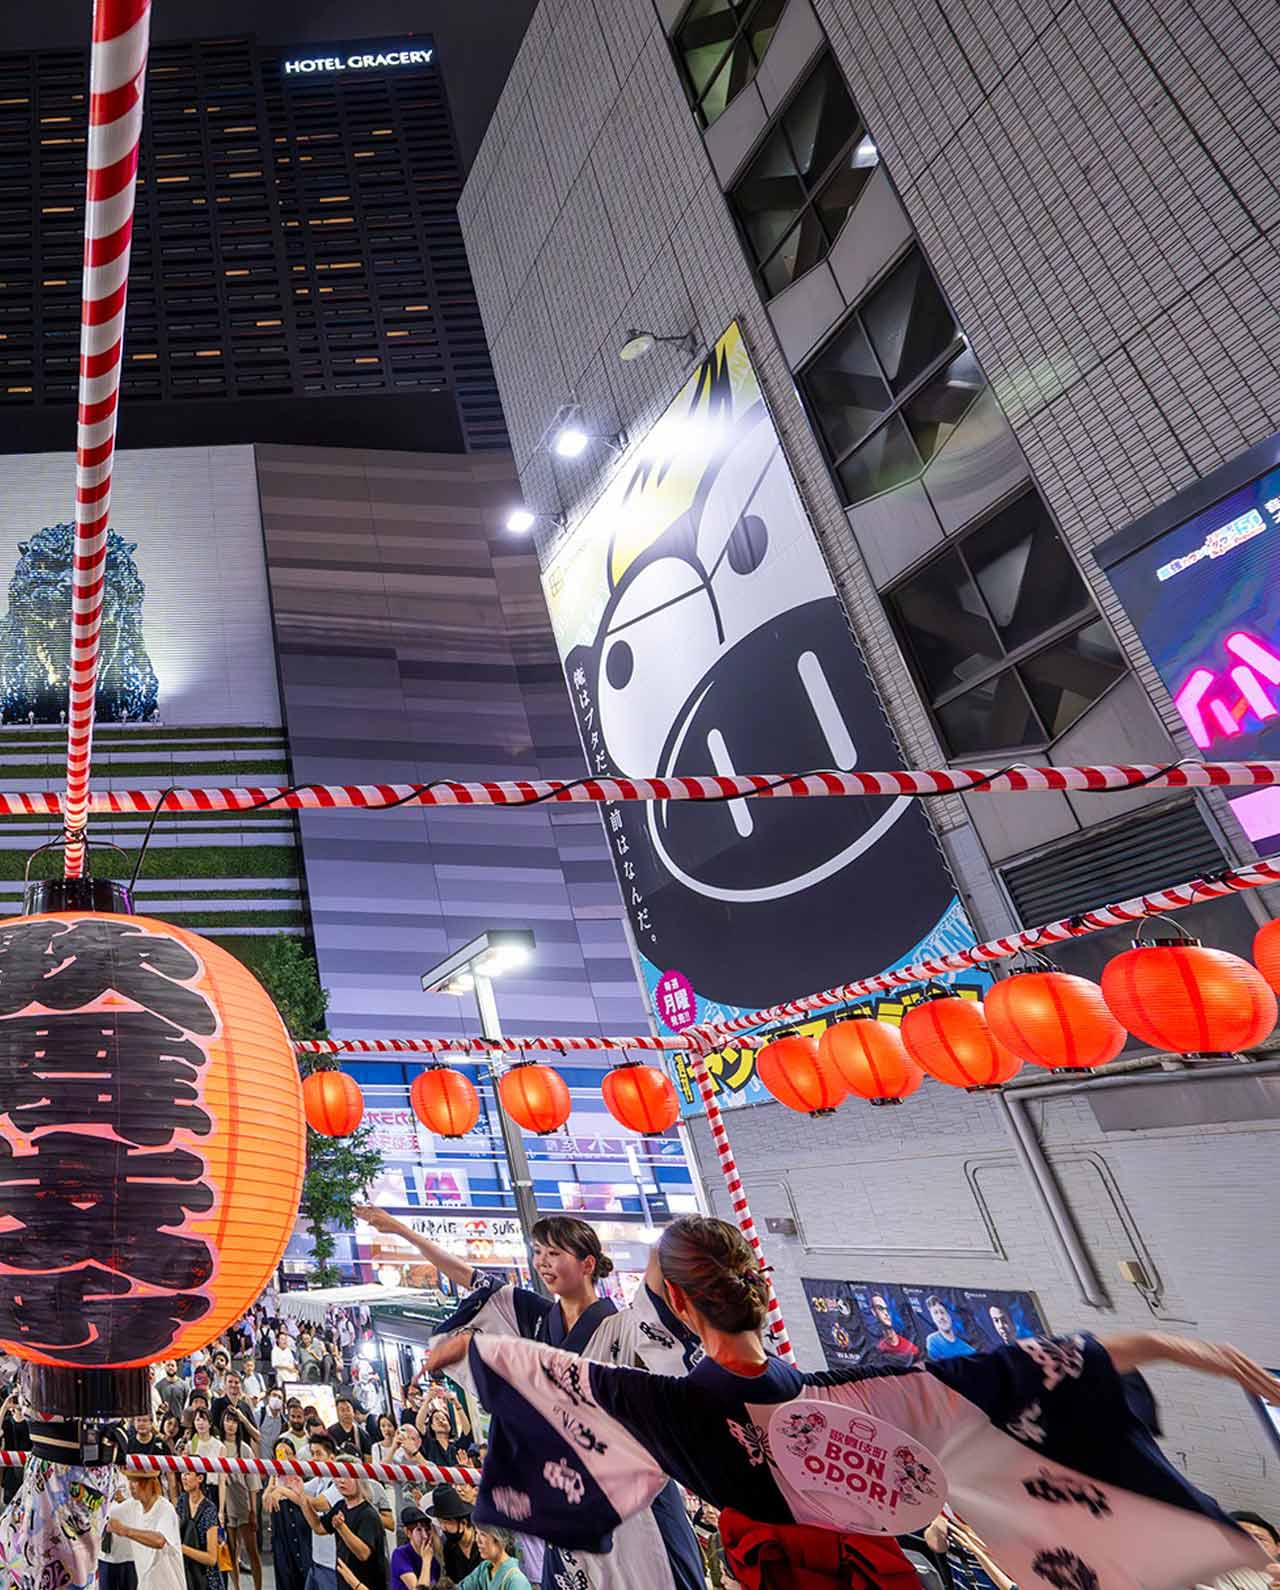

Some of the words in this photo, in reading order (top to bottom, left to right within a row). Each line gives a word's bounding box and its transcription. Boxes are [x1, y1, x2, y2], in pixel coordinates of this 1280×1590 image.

[285, 57, 345, 73] HOTEL
[347, 49, 433, 69] GRACERY
[663, 987, 691, 1015] 月曜
[824, 1441, 886, 1481] BON
[829, 1428, 889, 1461] 歌舞伎町
[804, 1455, 902, 1508] ODORI
